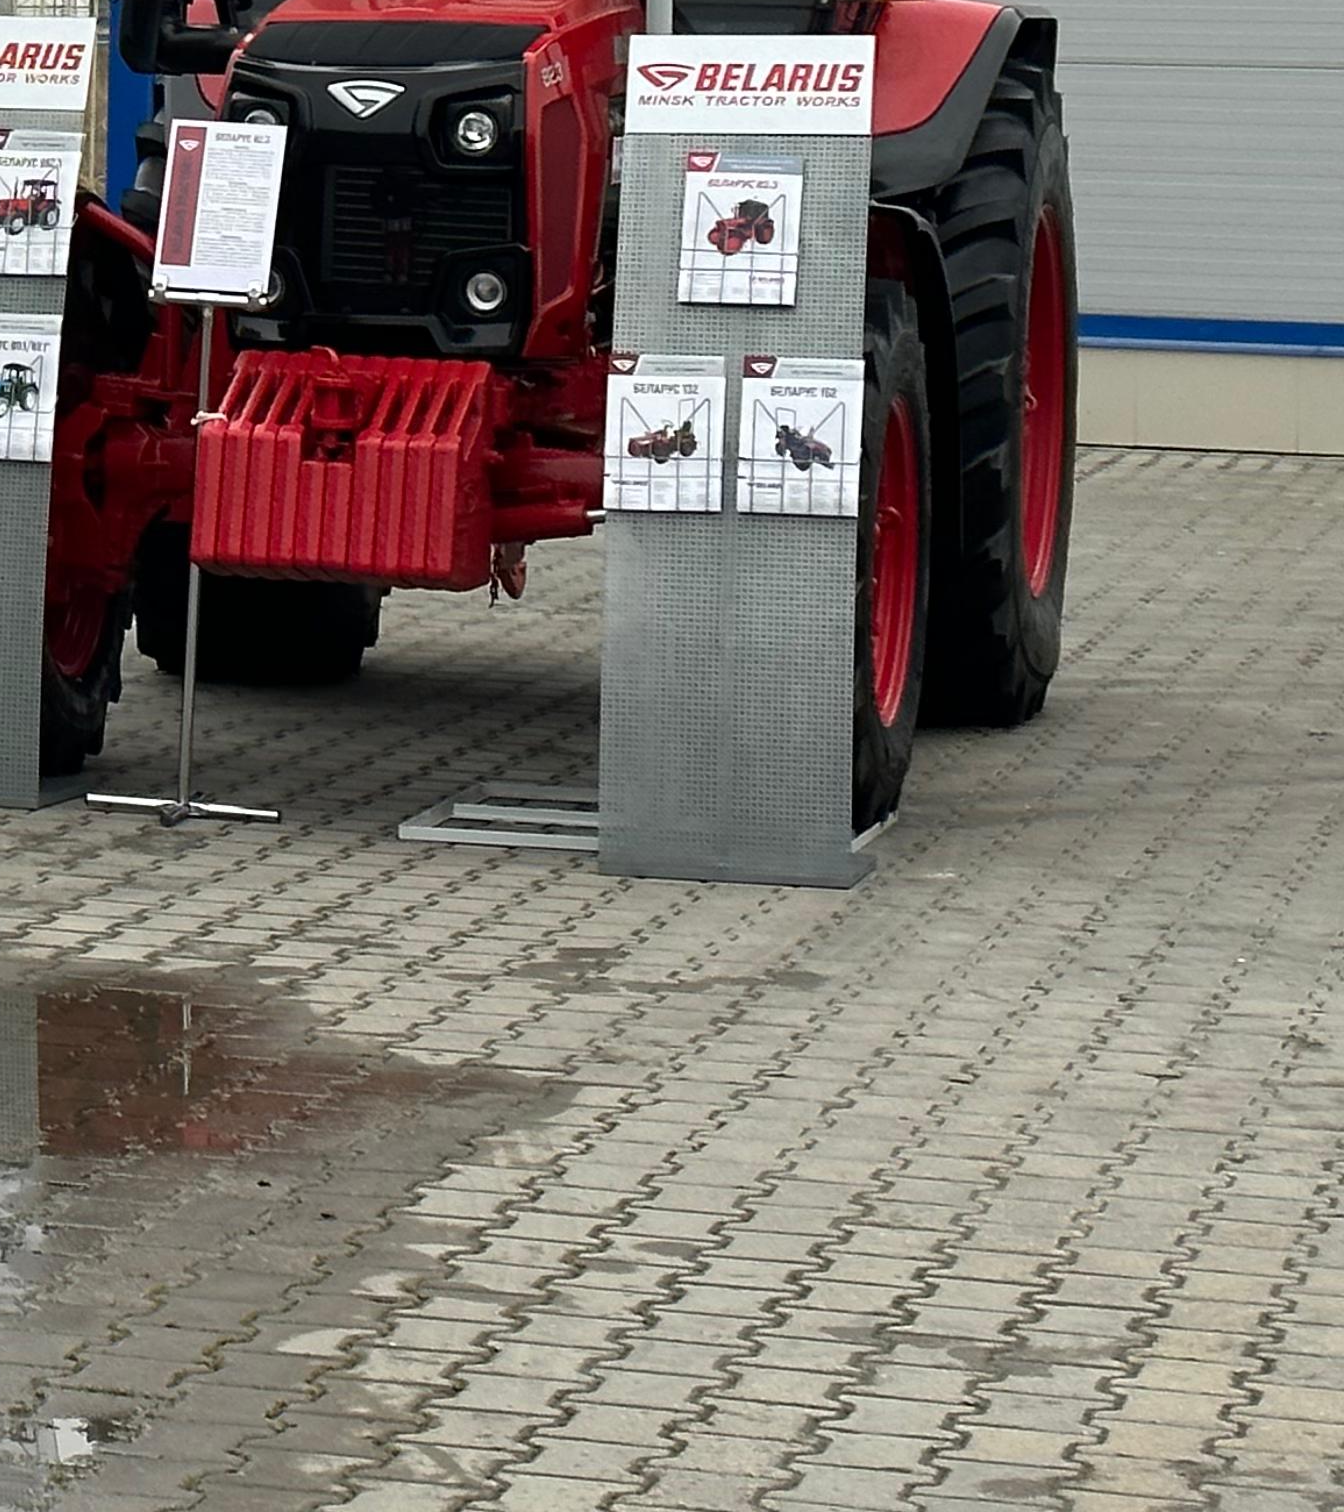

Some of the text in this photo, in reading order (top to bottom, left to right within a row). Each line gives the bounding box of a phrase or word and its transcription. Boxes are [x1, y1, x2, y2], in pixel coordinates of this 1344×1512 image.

[25, 73, 81, 85] WORKS
[694, 63, 865, 92] BELARUS
[637, 95, 861, 107] MINSK TRACTOR WORKS
